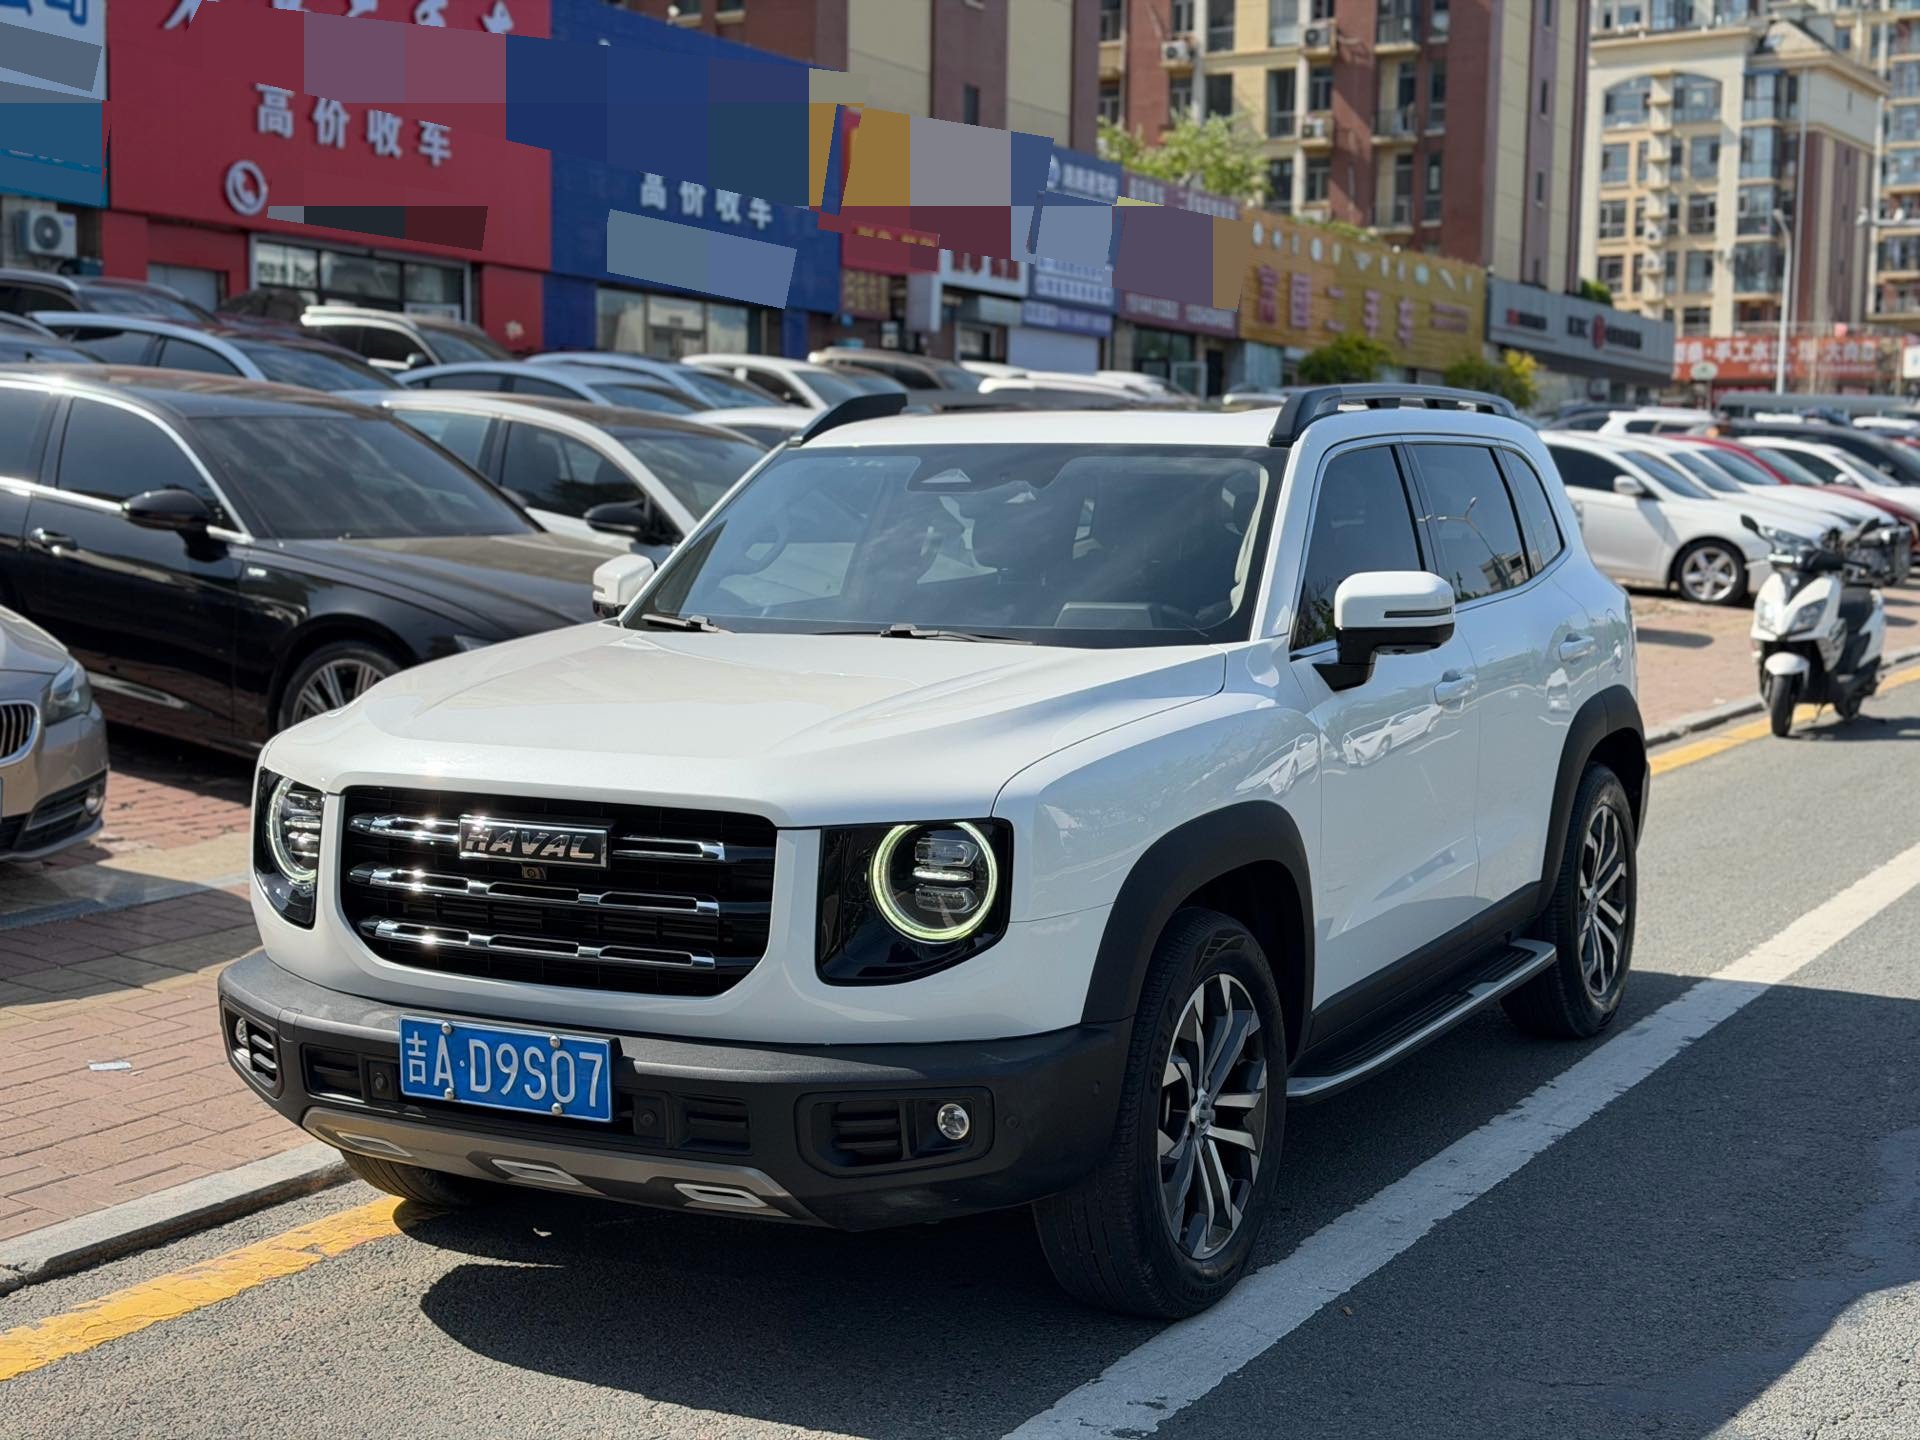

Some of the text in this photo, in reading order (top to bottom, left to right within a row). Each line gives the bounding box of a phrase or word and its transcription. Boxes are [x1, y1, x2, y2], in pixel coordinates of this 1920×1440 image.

[255, 83, 452, 167] 高价收车
[640, 172, 773, 230] 高价收车
[464, 827, 596, 860] HAVAL
[405, 1031, 603, 1108] 吉A·D9S07
